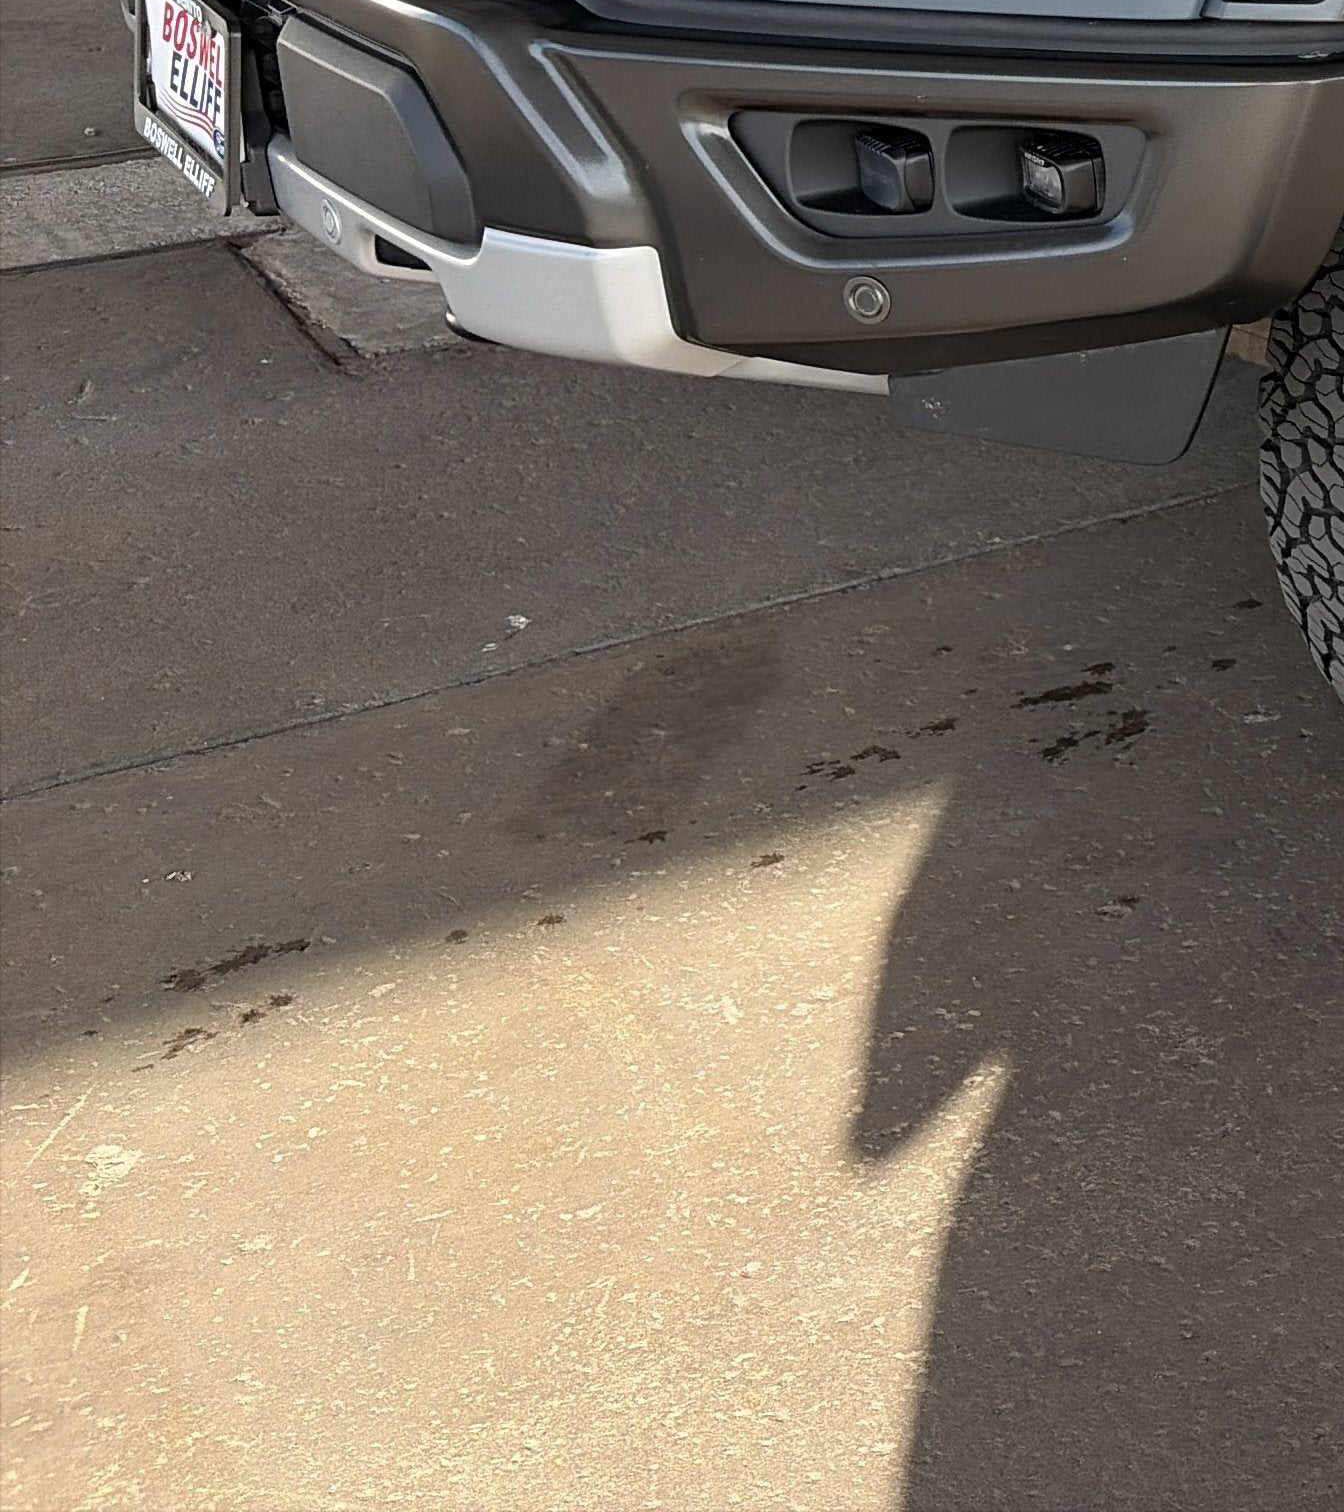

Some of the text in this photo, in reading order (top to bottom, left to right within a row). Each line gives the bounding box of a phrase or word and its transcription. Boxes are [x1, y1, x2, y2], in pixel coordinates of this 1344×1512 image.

[162, 1, 223, 89] BOSWEL
[170, 49, 222, 126] ELLIFF
[143, 117, 184, 170] BOSWELL
[183, 157, 216, 199] ELLIFF
